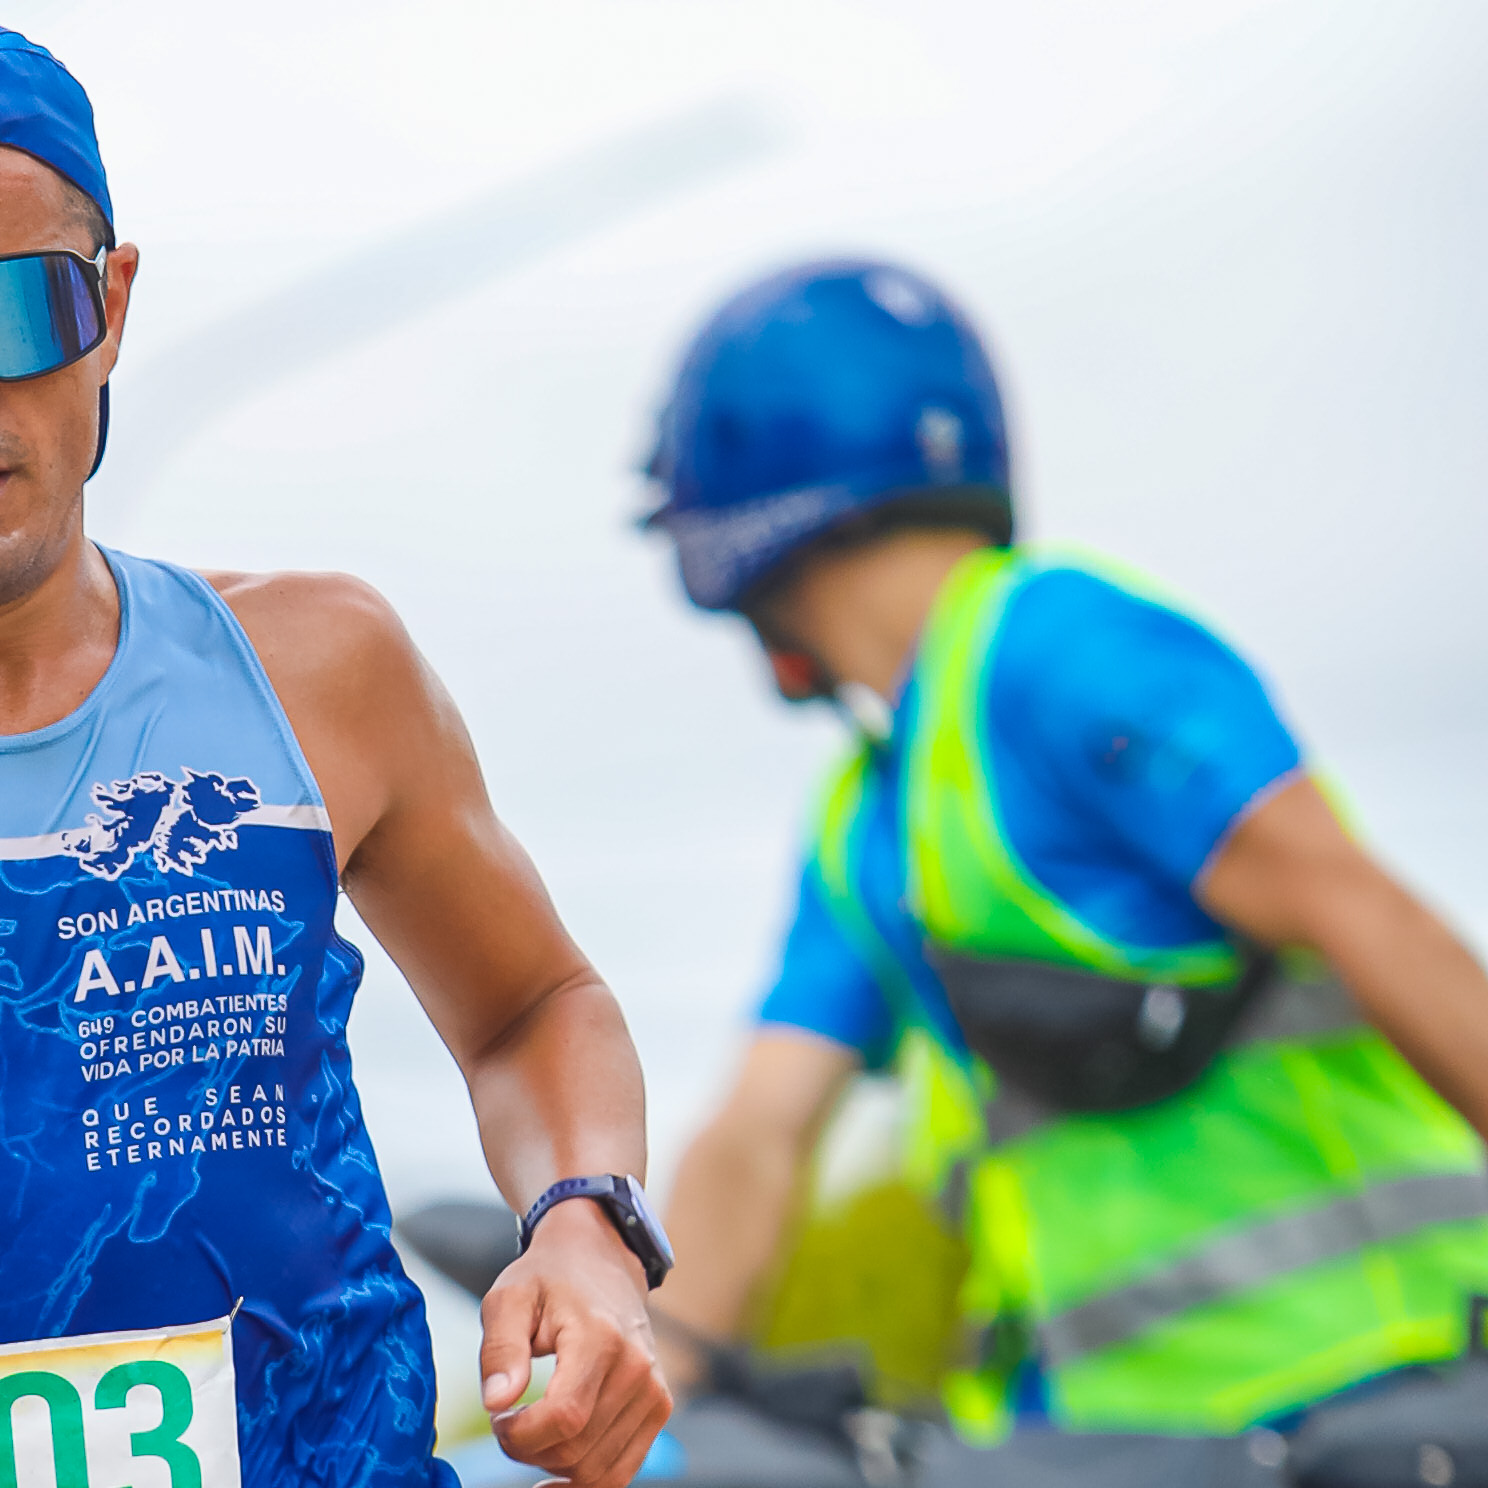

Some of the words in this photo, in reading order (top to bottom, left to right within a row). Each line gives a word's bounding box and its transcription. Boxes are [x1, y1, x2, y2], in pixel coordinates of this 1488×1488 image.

[57, 908, 119, 940] SON
[126, 889, 287, 926] ARGENTINAS
[73, 925, 287, 1003] A.A.I.M.
[77, 1016, 115, 1039] 649
[130, 993, 288, 1028] COMBATIENTES
[79, 1017, 253, 1060] OFRENDARON
[264, 1016, 287, 1034] SU
[80, 1058, 132, 1083] VIDA
[139, 1048, 185, 1072] POR
[192, 1042, 220, 1063] LA
[226, 1038, 286, 1058] PATRIA
[82, 1096, 159, 1127] QUE
[205, 1084, 285, 1106] SEAN
[84, 1106, 287, 1149] RECORDADOS
[86, 1128, 288, 1171] ETERNAMENTE
